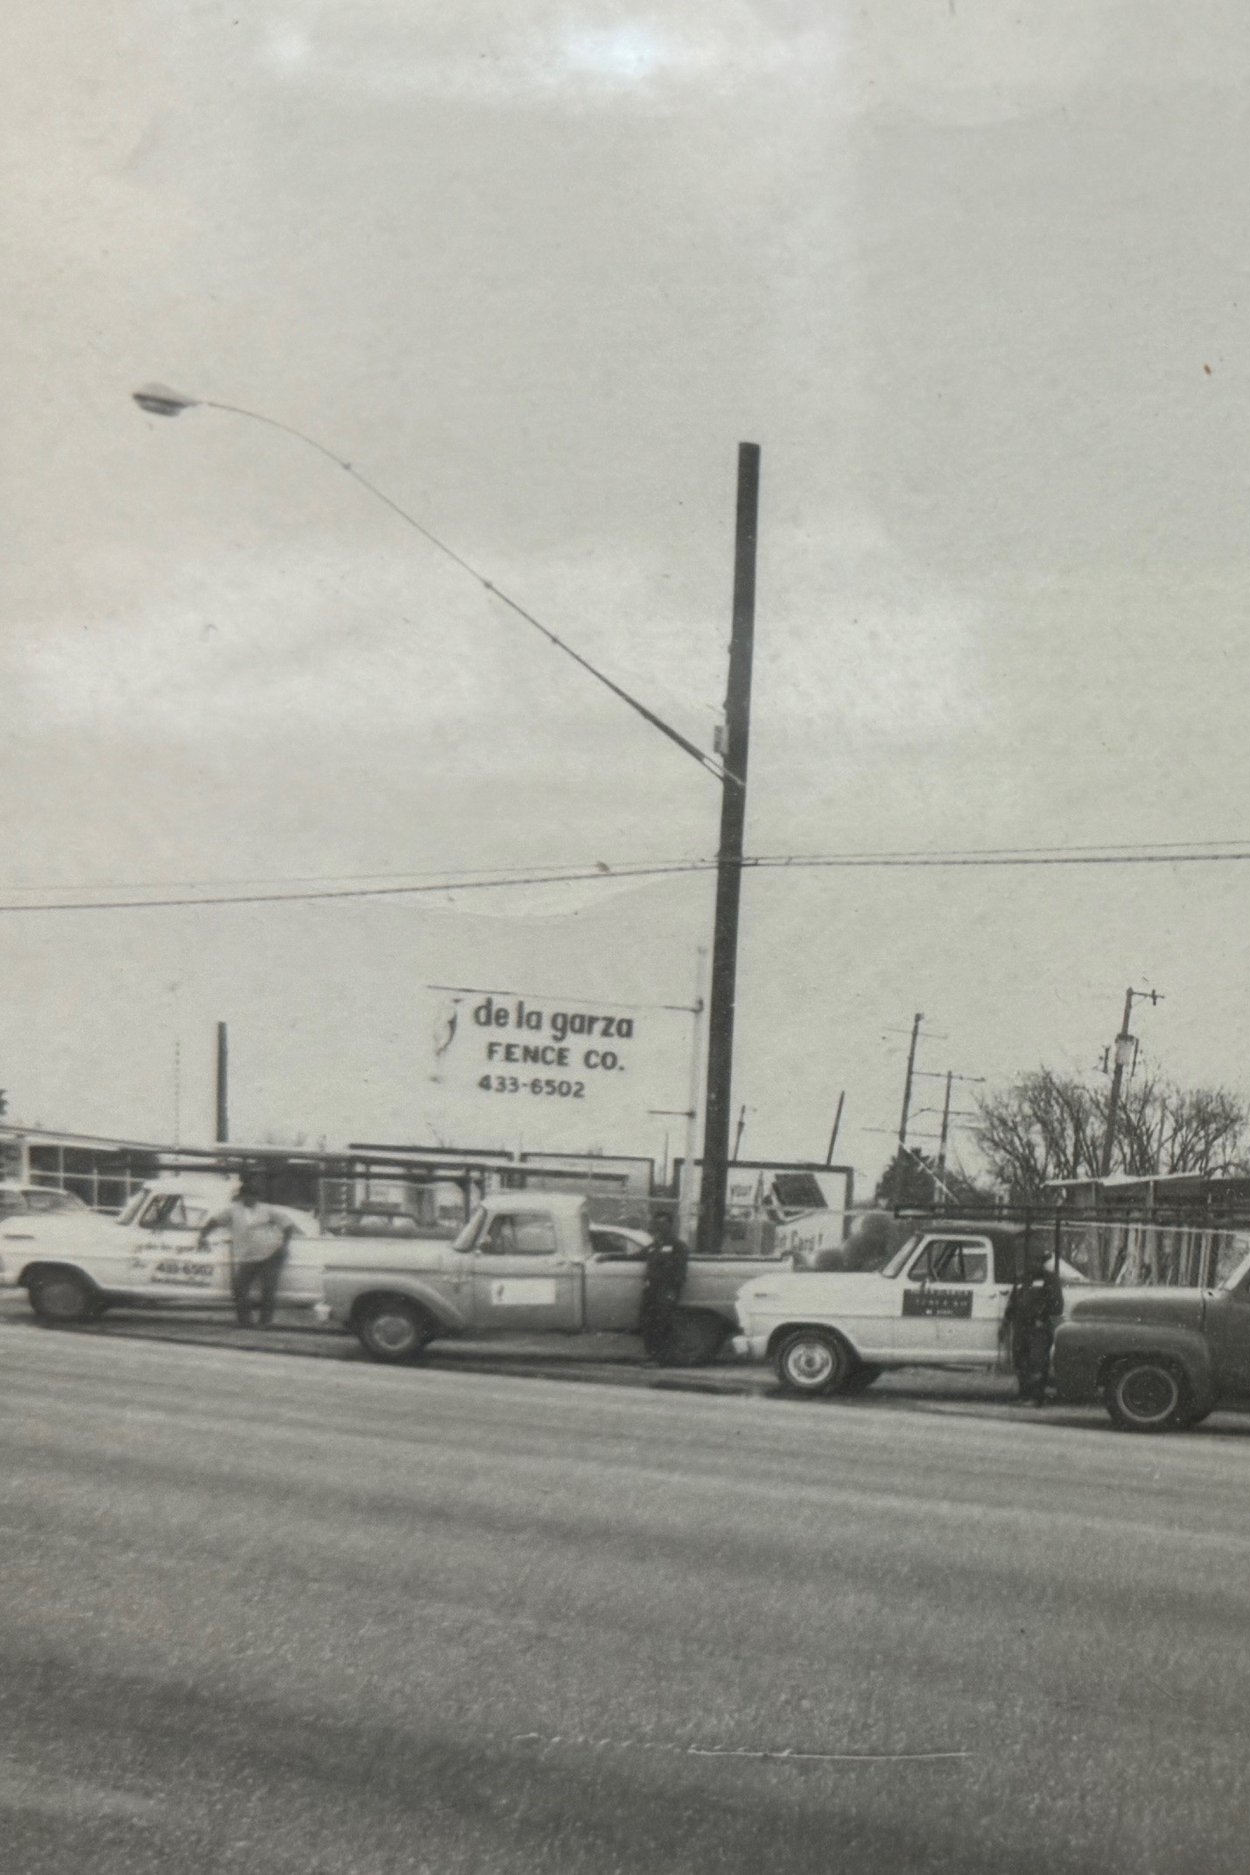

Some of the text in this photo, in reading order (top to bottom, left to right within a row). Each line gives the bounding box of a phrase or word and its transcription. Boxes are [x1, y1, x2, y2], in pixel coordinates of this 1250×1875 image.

[473, 997, 634, 1041] de la garza
[487, 1042, 625, 1071] FENCE CO.
[478, 1074, 585, 1098] 433-6502
